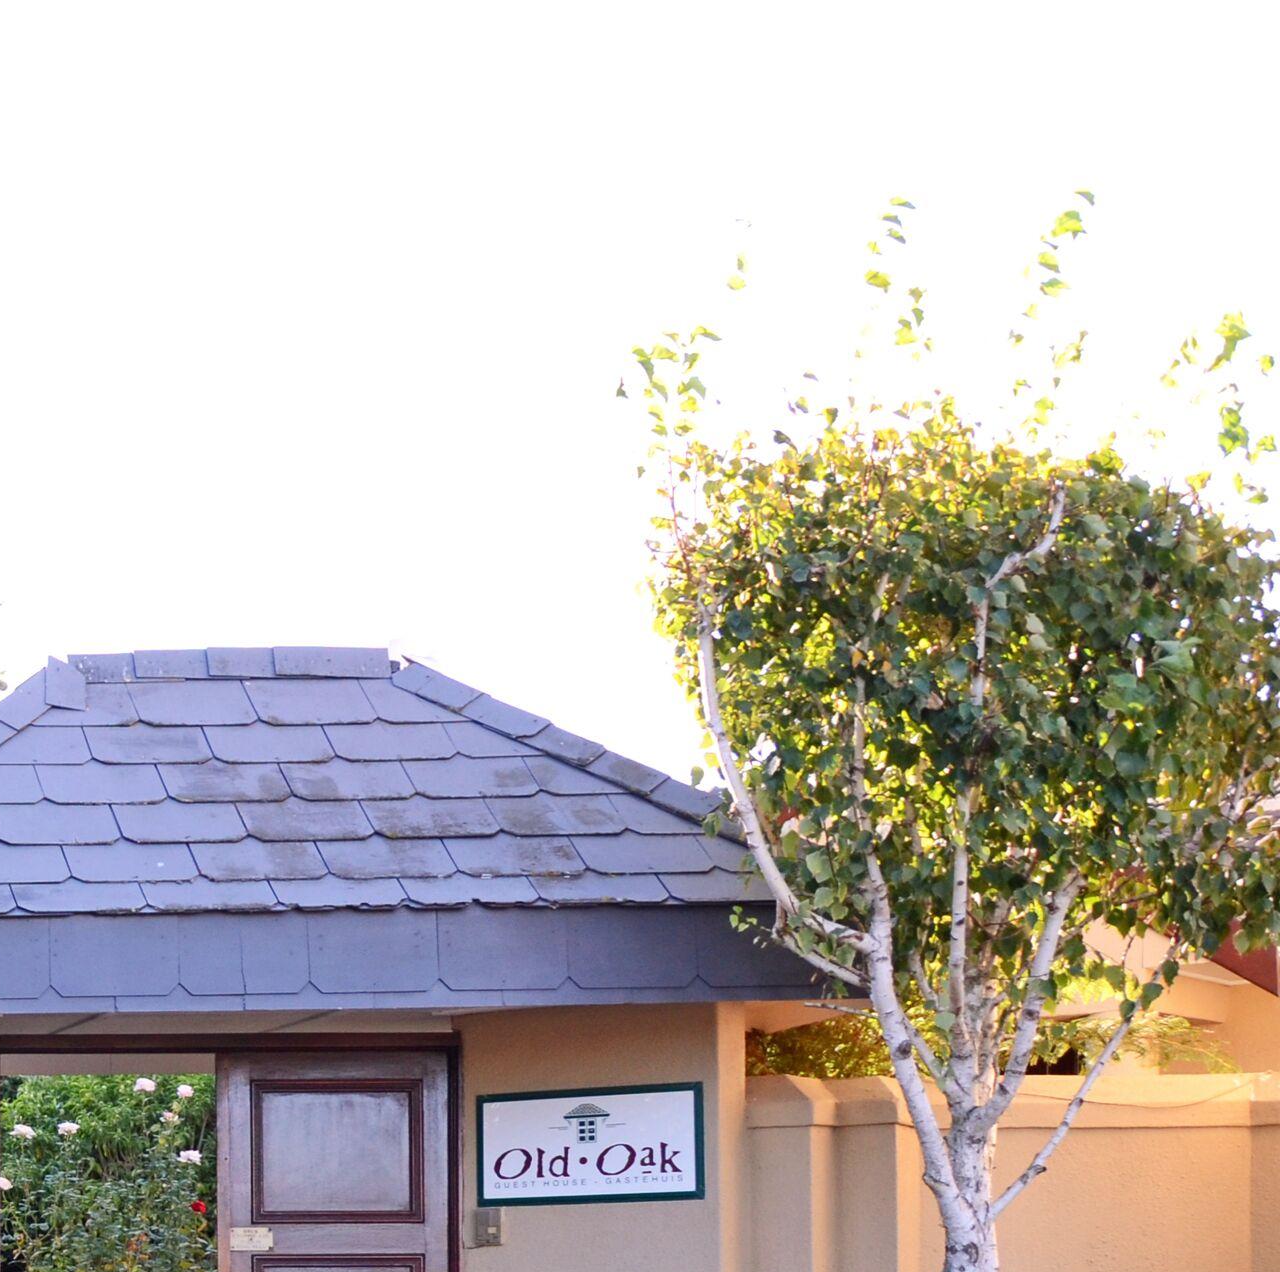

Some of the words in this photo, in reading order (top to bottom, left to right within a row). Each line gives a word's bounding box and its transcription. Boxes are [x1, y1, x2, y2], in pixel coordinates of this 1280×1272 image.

[493, 1146, 570, 1180] Old
[596, 1142, 682, 1176] Oak
[494, 1181, 536, 1189] GUEST
[543, 1179, 587, 1187] HOUSE
[605, 1174, 684, 1185] GASTEHUIS
